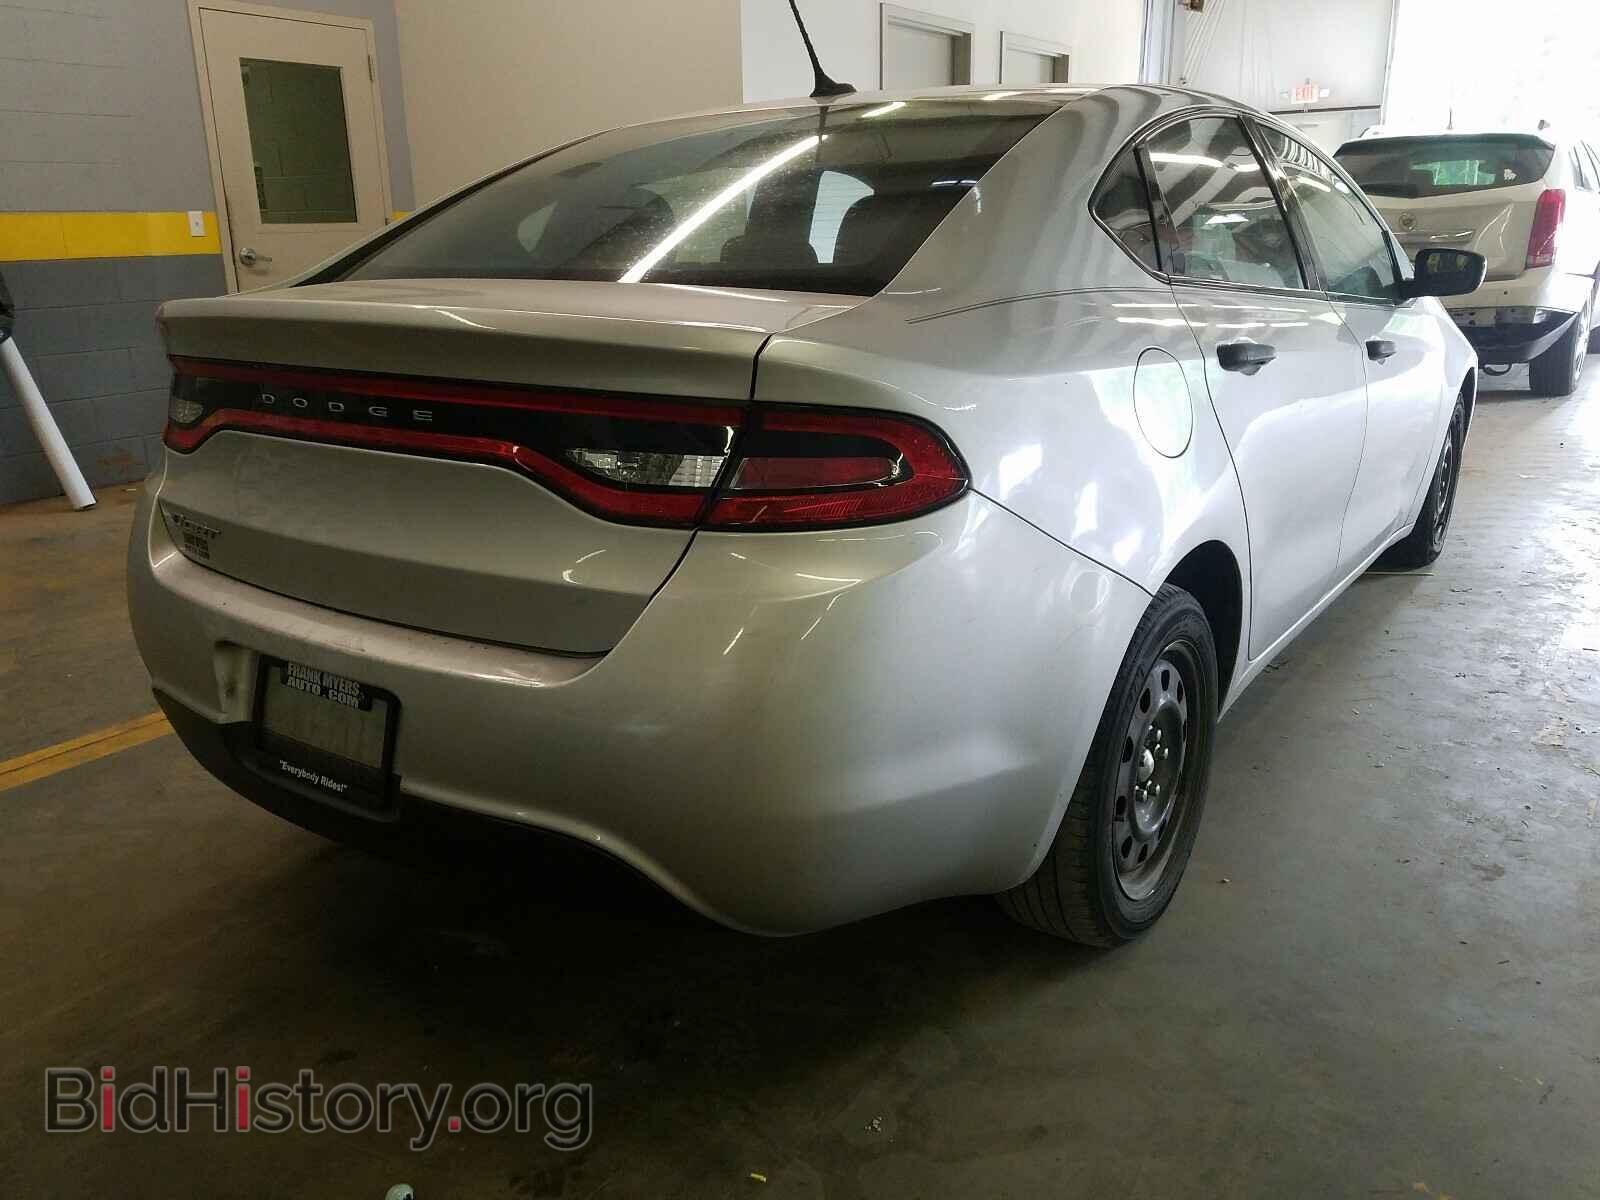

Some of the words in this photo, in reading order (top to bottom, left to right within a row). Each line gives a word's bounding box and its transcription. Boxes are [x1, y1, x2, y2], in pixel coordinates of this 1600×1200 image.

[261, 393, 433, 421] DODGE
[288, 663, 321, 684] FRANK
[322, 672, 360, 696] MYERS
